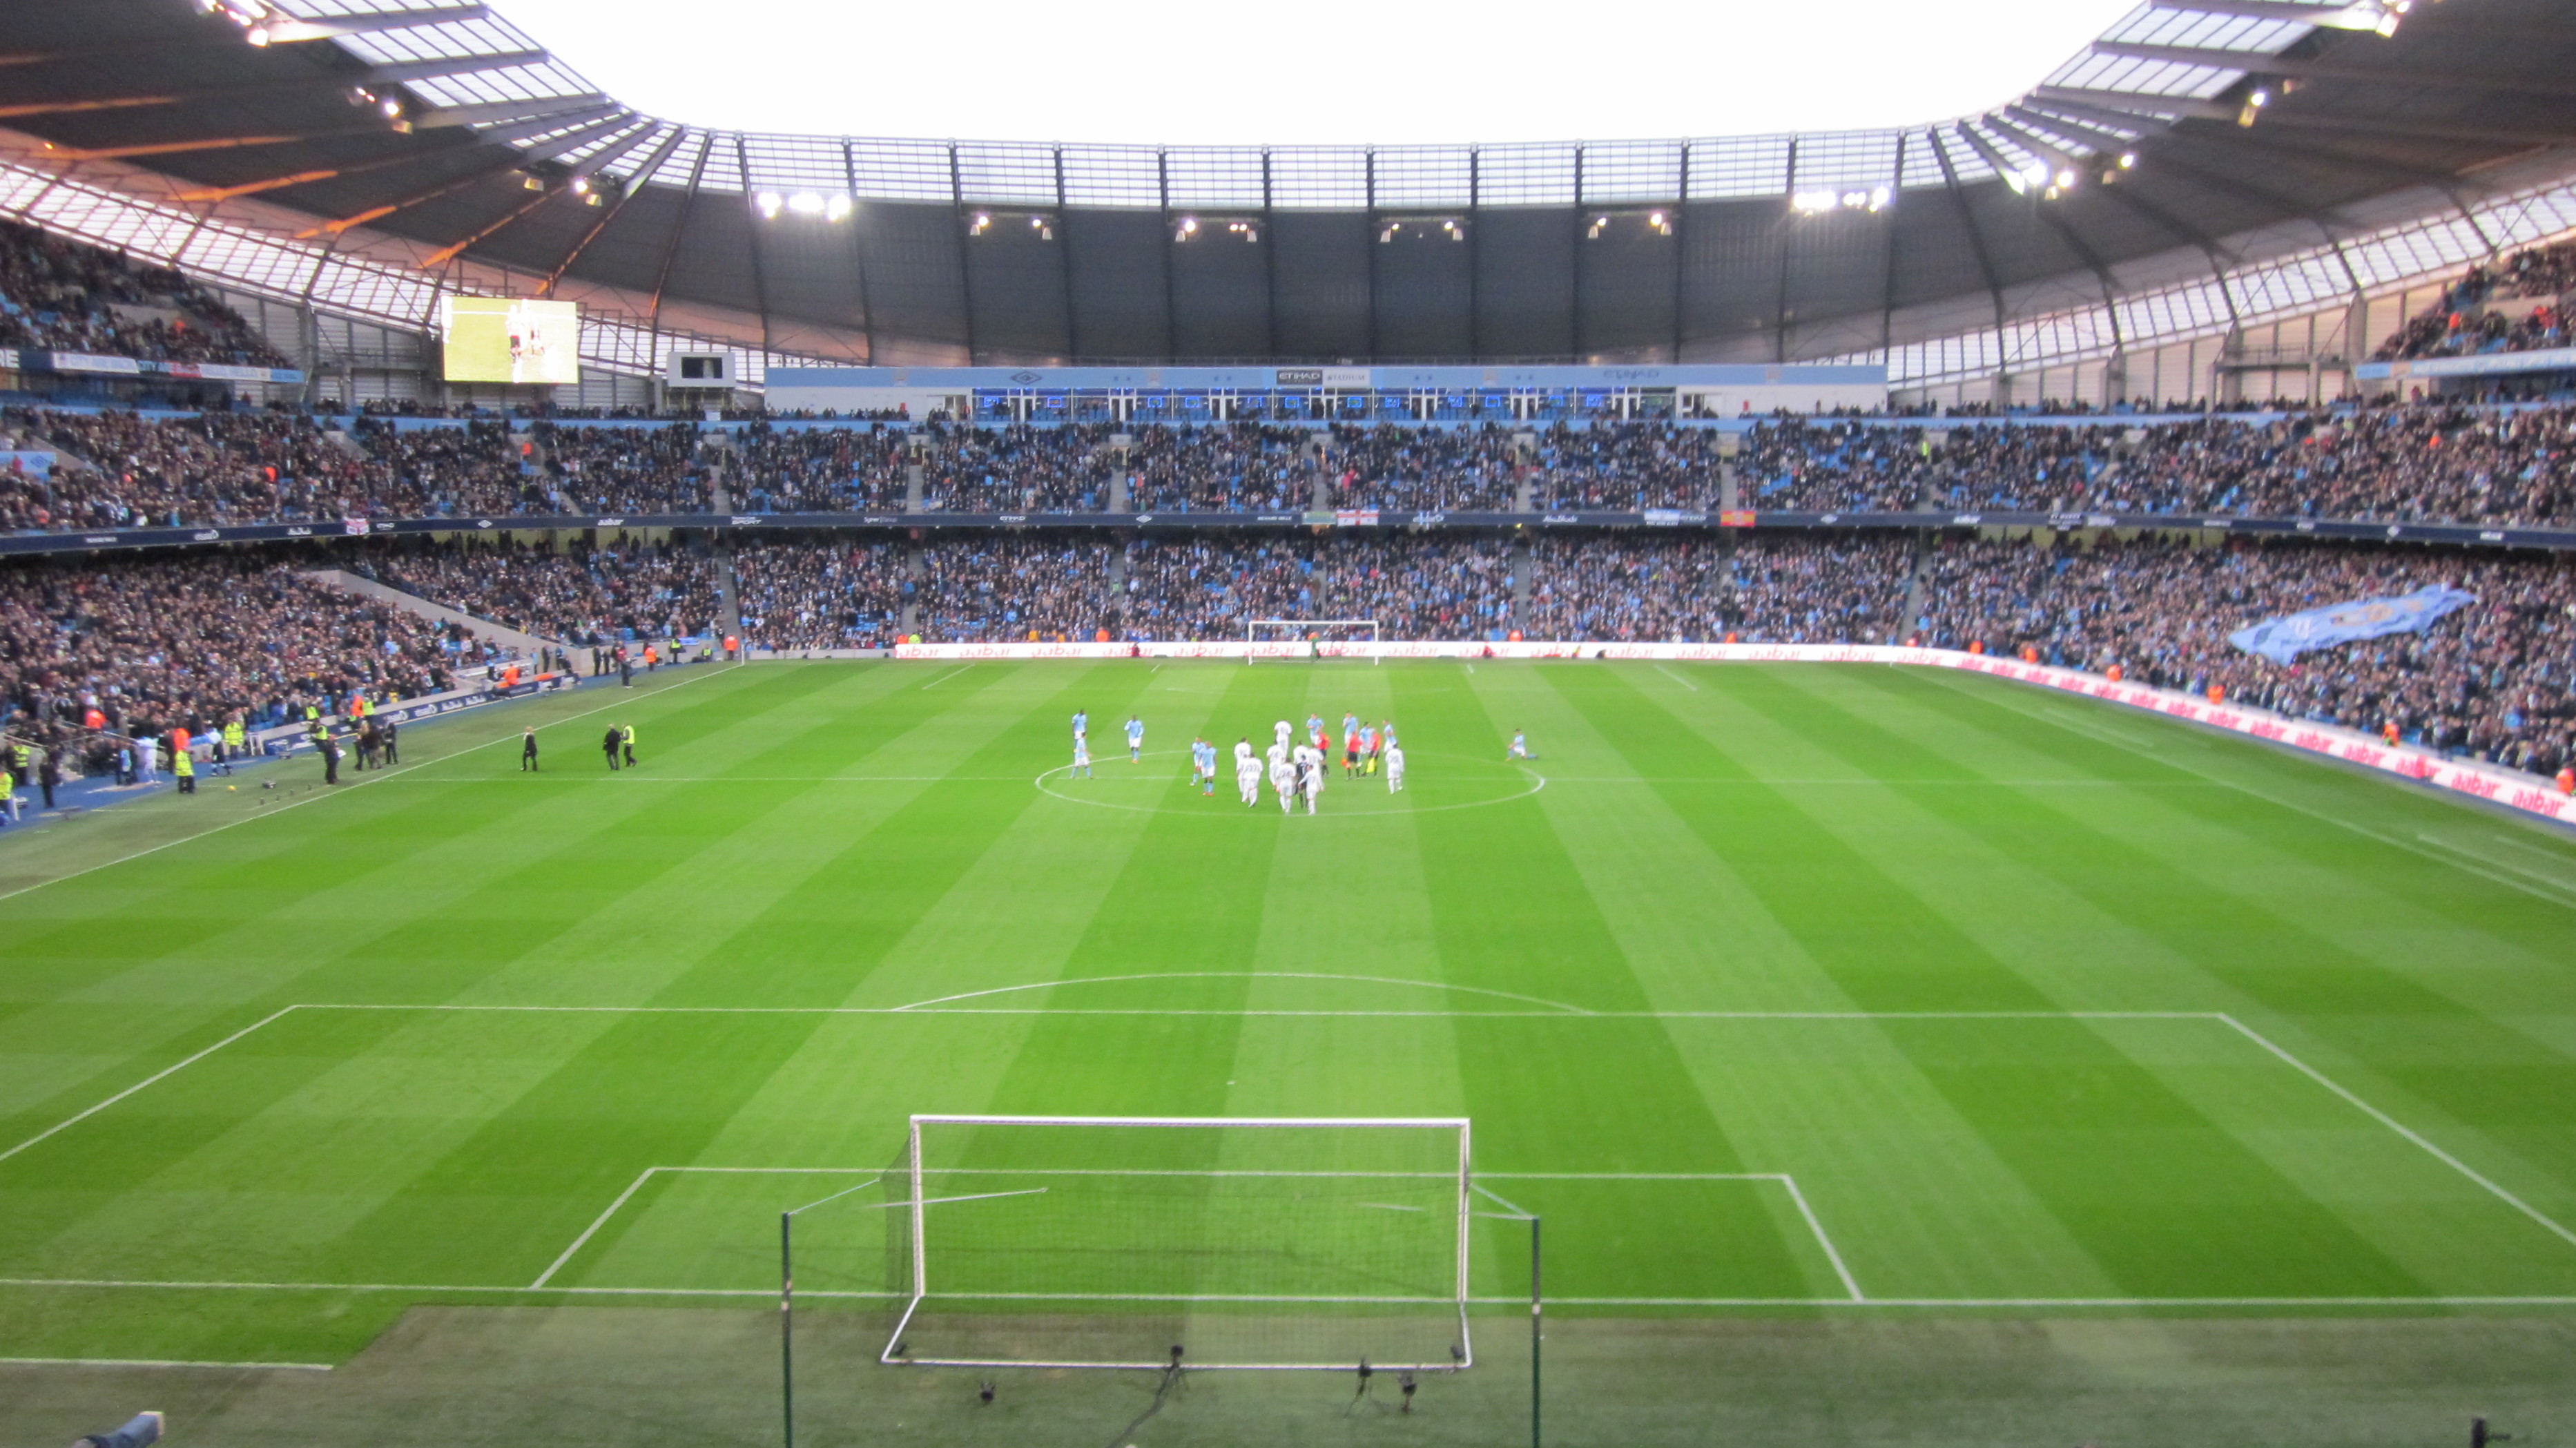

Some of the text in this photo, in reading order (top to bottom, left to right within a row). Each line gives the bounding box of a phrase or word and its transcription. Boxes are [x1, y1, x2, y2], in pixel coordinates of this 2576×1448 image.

[1279, 372, 1321, 380] ETIHAD
[1032, 642, 1083, 657] aabar
[2451, 769, 2502, 799] aabar
[2512, 786, 2566, 818] aabar
